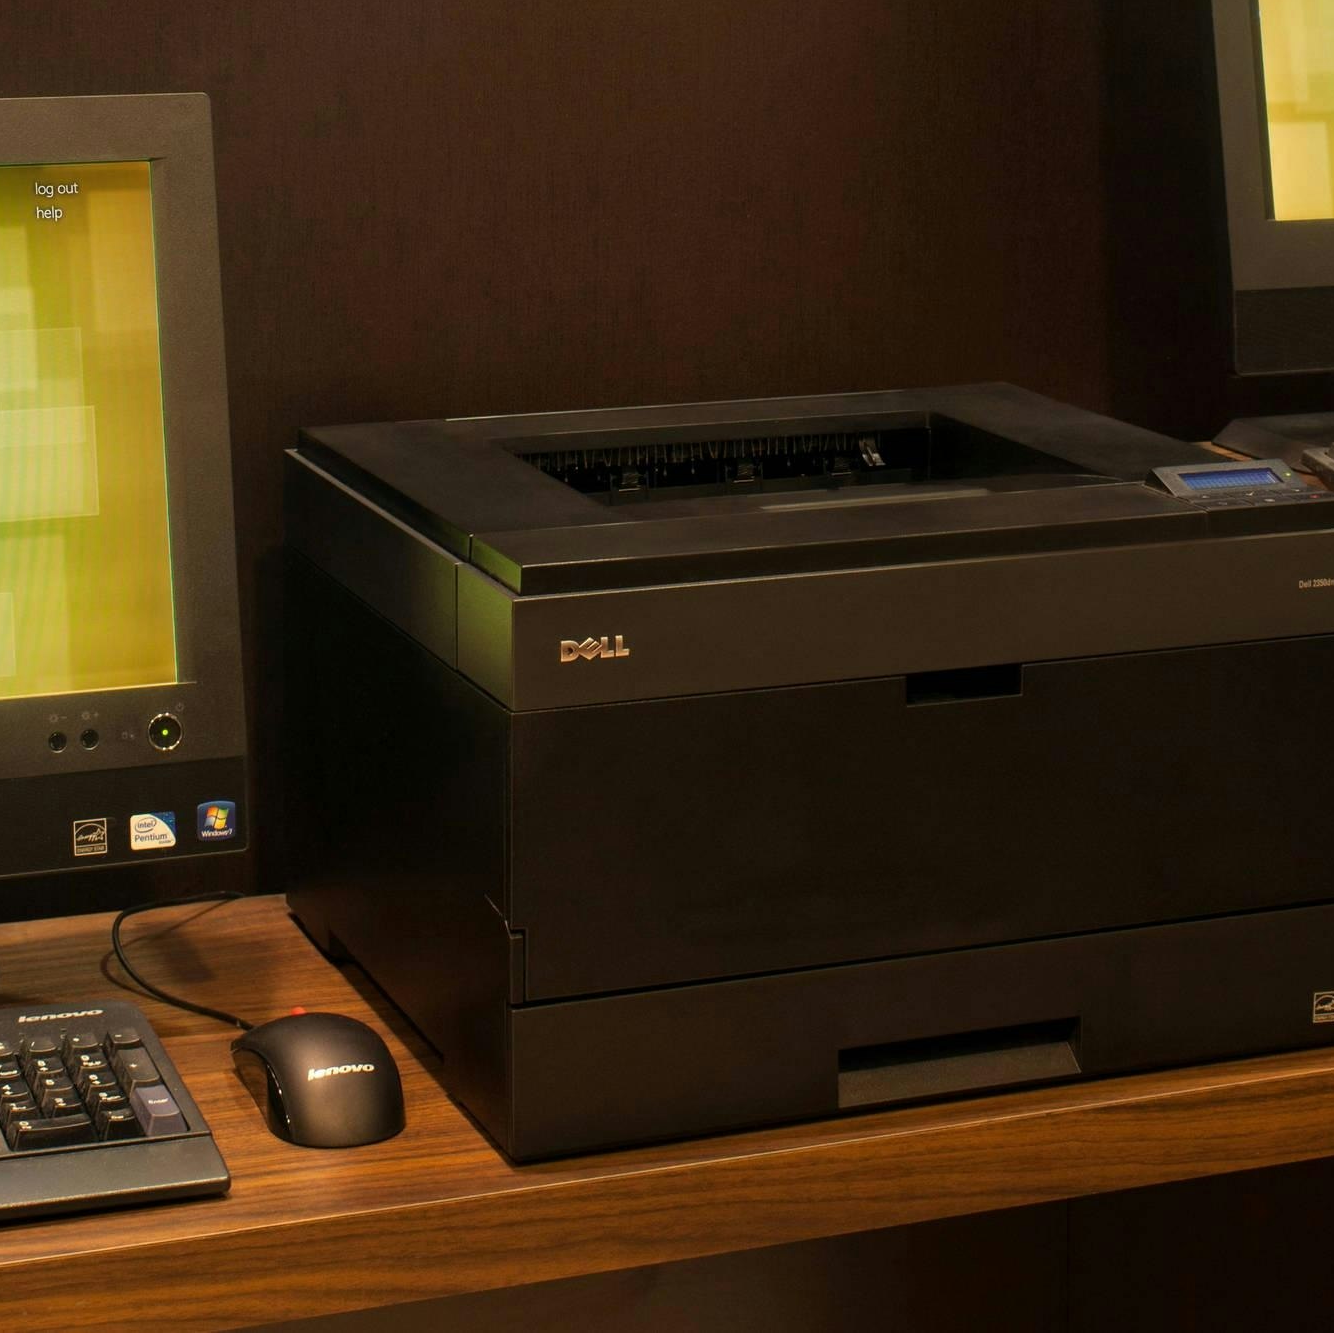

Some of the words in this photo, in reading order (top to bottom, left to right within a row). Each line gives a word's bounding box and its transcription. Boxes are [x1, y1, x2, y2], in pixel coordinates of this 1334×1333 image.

[35, 182, 54, 198] log
[57, 182, 79, 194] out
[36, 205, 63, 222] help
[560, 635, 630, 663] DELL
[134, 833, 168, 842] Pentium
[18, 1009, 104, 1023] lenovo
[307, 1063, 375, 1082] lenovo
